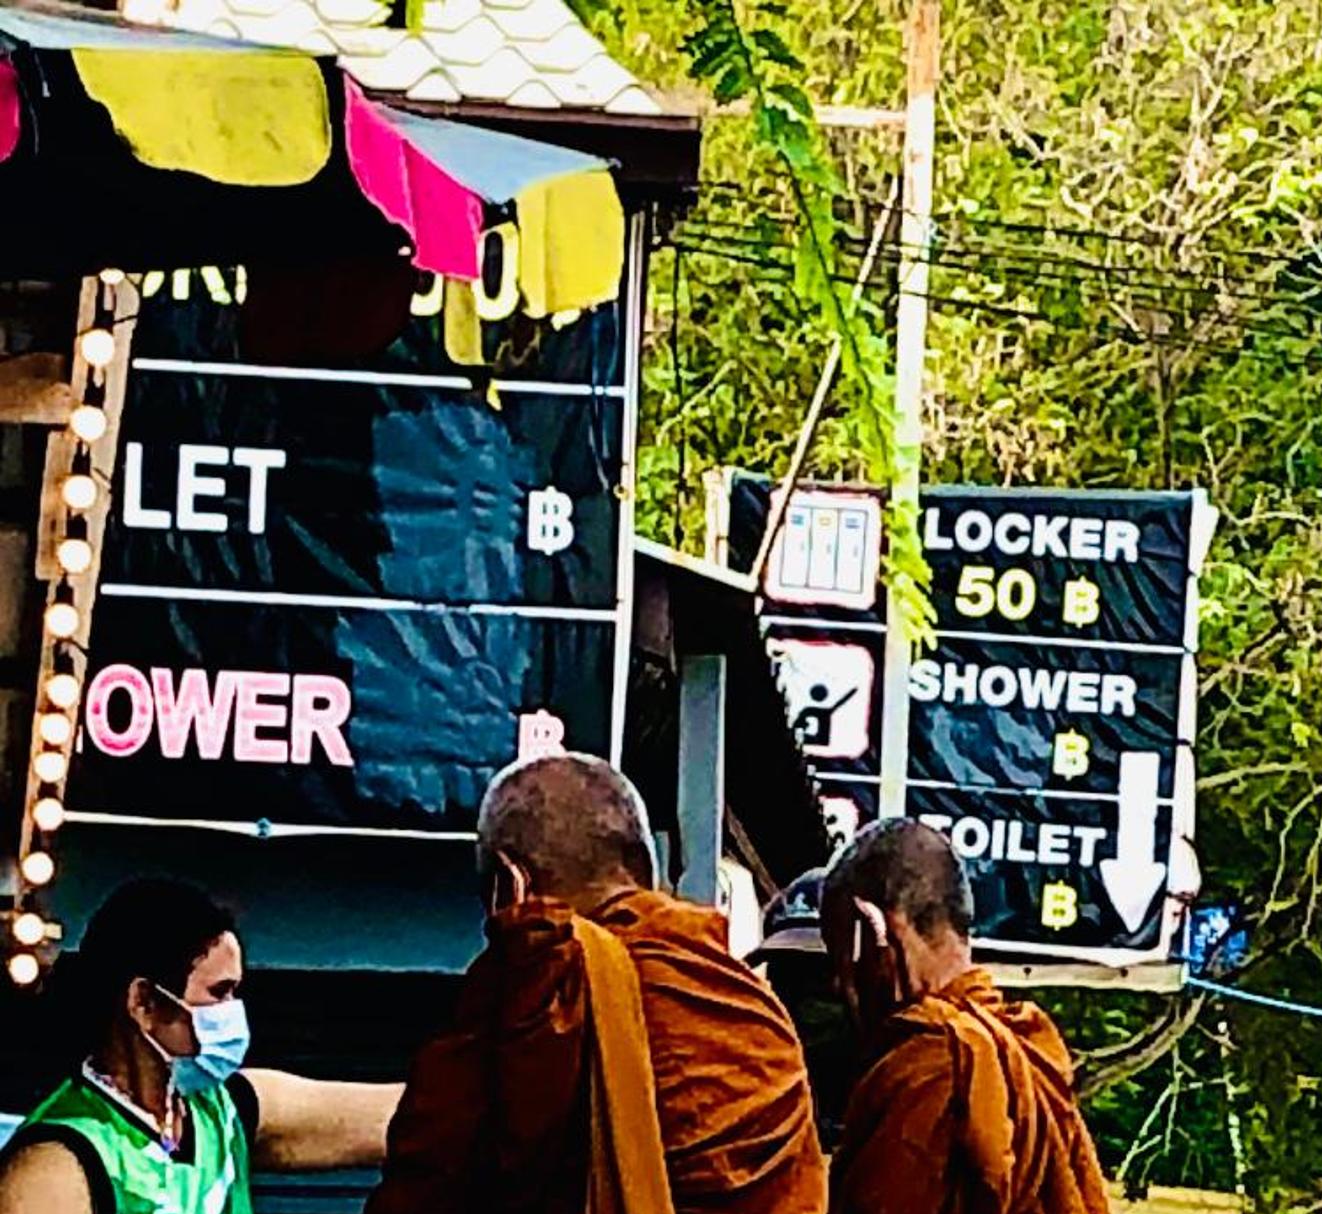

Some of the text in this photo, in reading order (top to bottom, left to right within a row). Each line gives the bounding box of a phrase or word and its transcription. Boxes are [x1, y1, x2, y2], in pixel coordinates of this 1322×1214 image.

[923, 507, 1140, 563] LOCKER
[955, 564, 1036, 621] 50
[907, 659, 1138, 717] SHOWER
[918, 813, 1107, 868] TOILET
